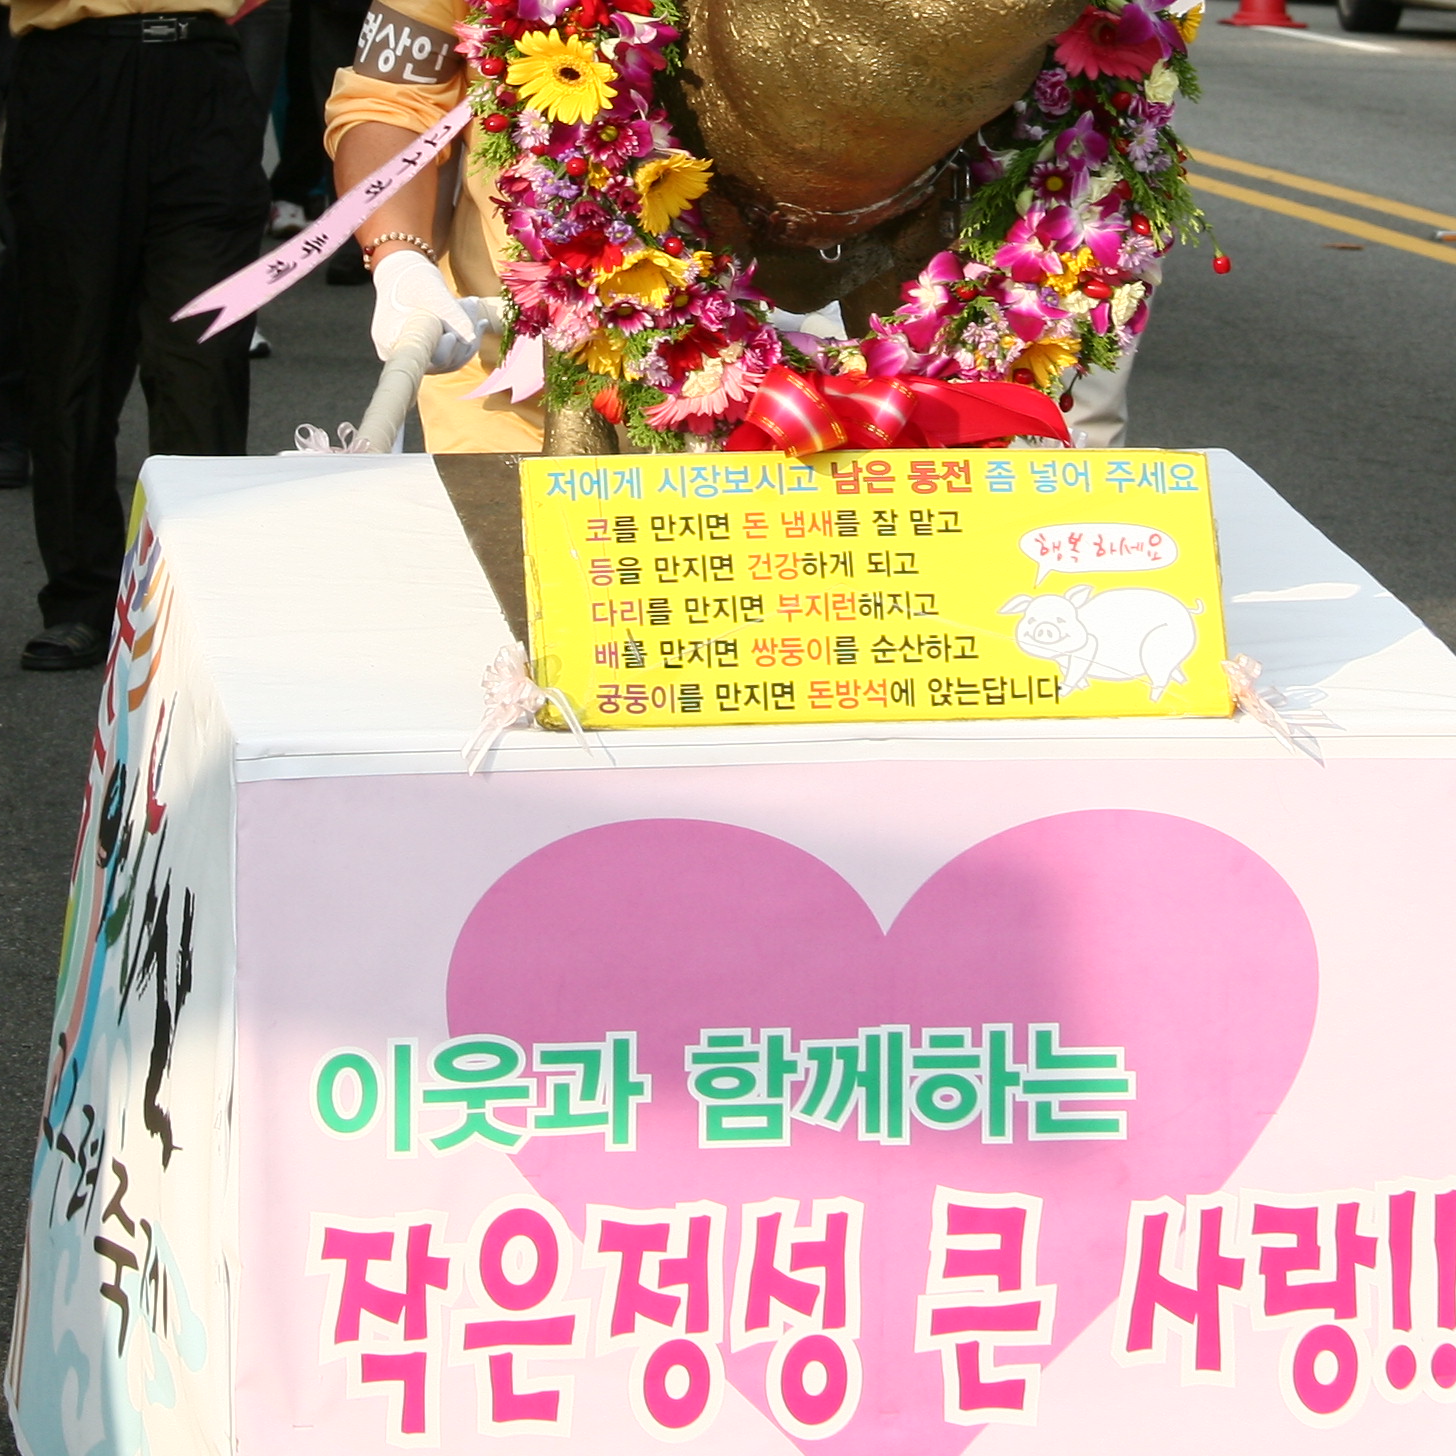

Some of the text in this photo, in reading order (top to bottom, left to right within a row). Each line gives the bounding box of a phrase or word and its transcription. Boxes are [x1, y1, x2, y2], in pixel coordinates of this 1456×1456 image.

[547, 458, 1199, 501] 저에게 시장보시고 남은 동전 좀 넣어 주세요
[586, 509, 962, 543] 코를 만지면 돈 냄새를 잘 맡고
[589, 551, 919, 586] 등을 만지면 건강하게 되고
[592, 591, 939, 630] 다리를 만지면 부지런해지고
[595, 634, 979, 669] 배를 만지면 쌍둥이를 순산하고
[596, 676, 1062, 714] 궁둥이를 만지면 돈방석에 앉는답니다
[318, 1029, 1129, 1152] 이웃과 함께하는
[932, 1204, 1041, 1412] 큰
